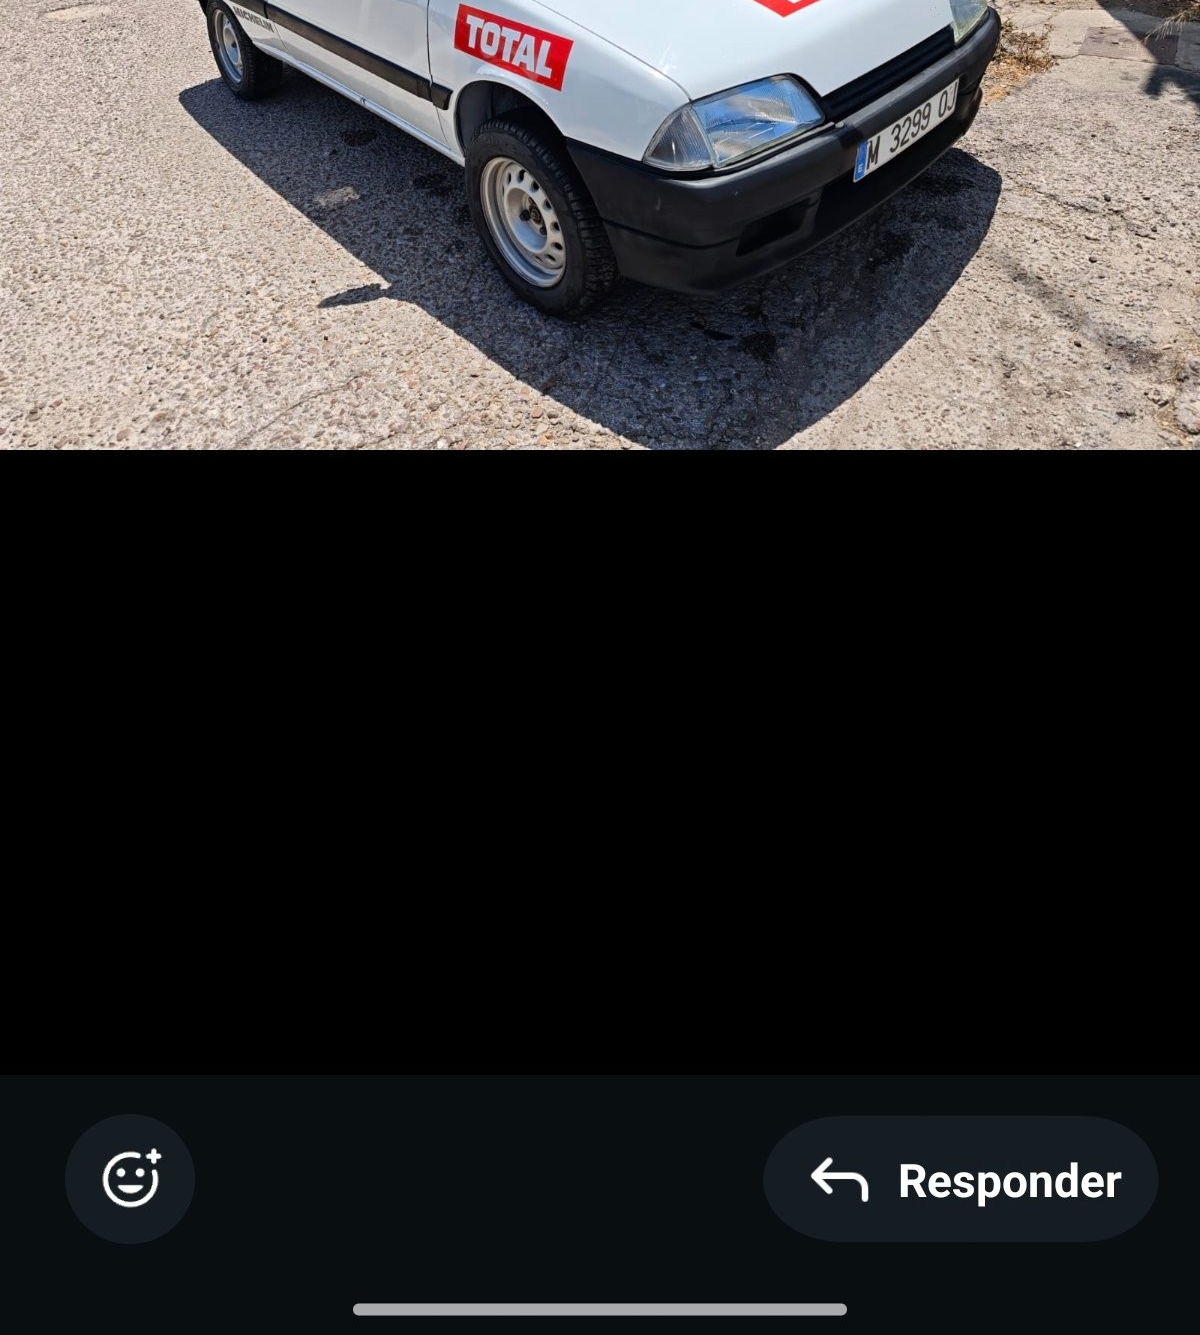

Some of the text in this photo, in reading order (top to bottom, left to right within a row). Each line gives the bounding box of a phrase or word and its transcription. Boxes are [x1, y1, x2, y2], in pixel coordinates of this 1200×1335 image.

[232, 5, 275, 34] MICHELIN
[466, 14, 553, 79] TOTAL
[866, 135, 881, 170] M
[889, 101, 932, 153] 3299
[900, 1161, 1123, 1208] Responder
